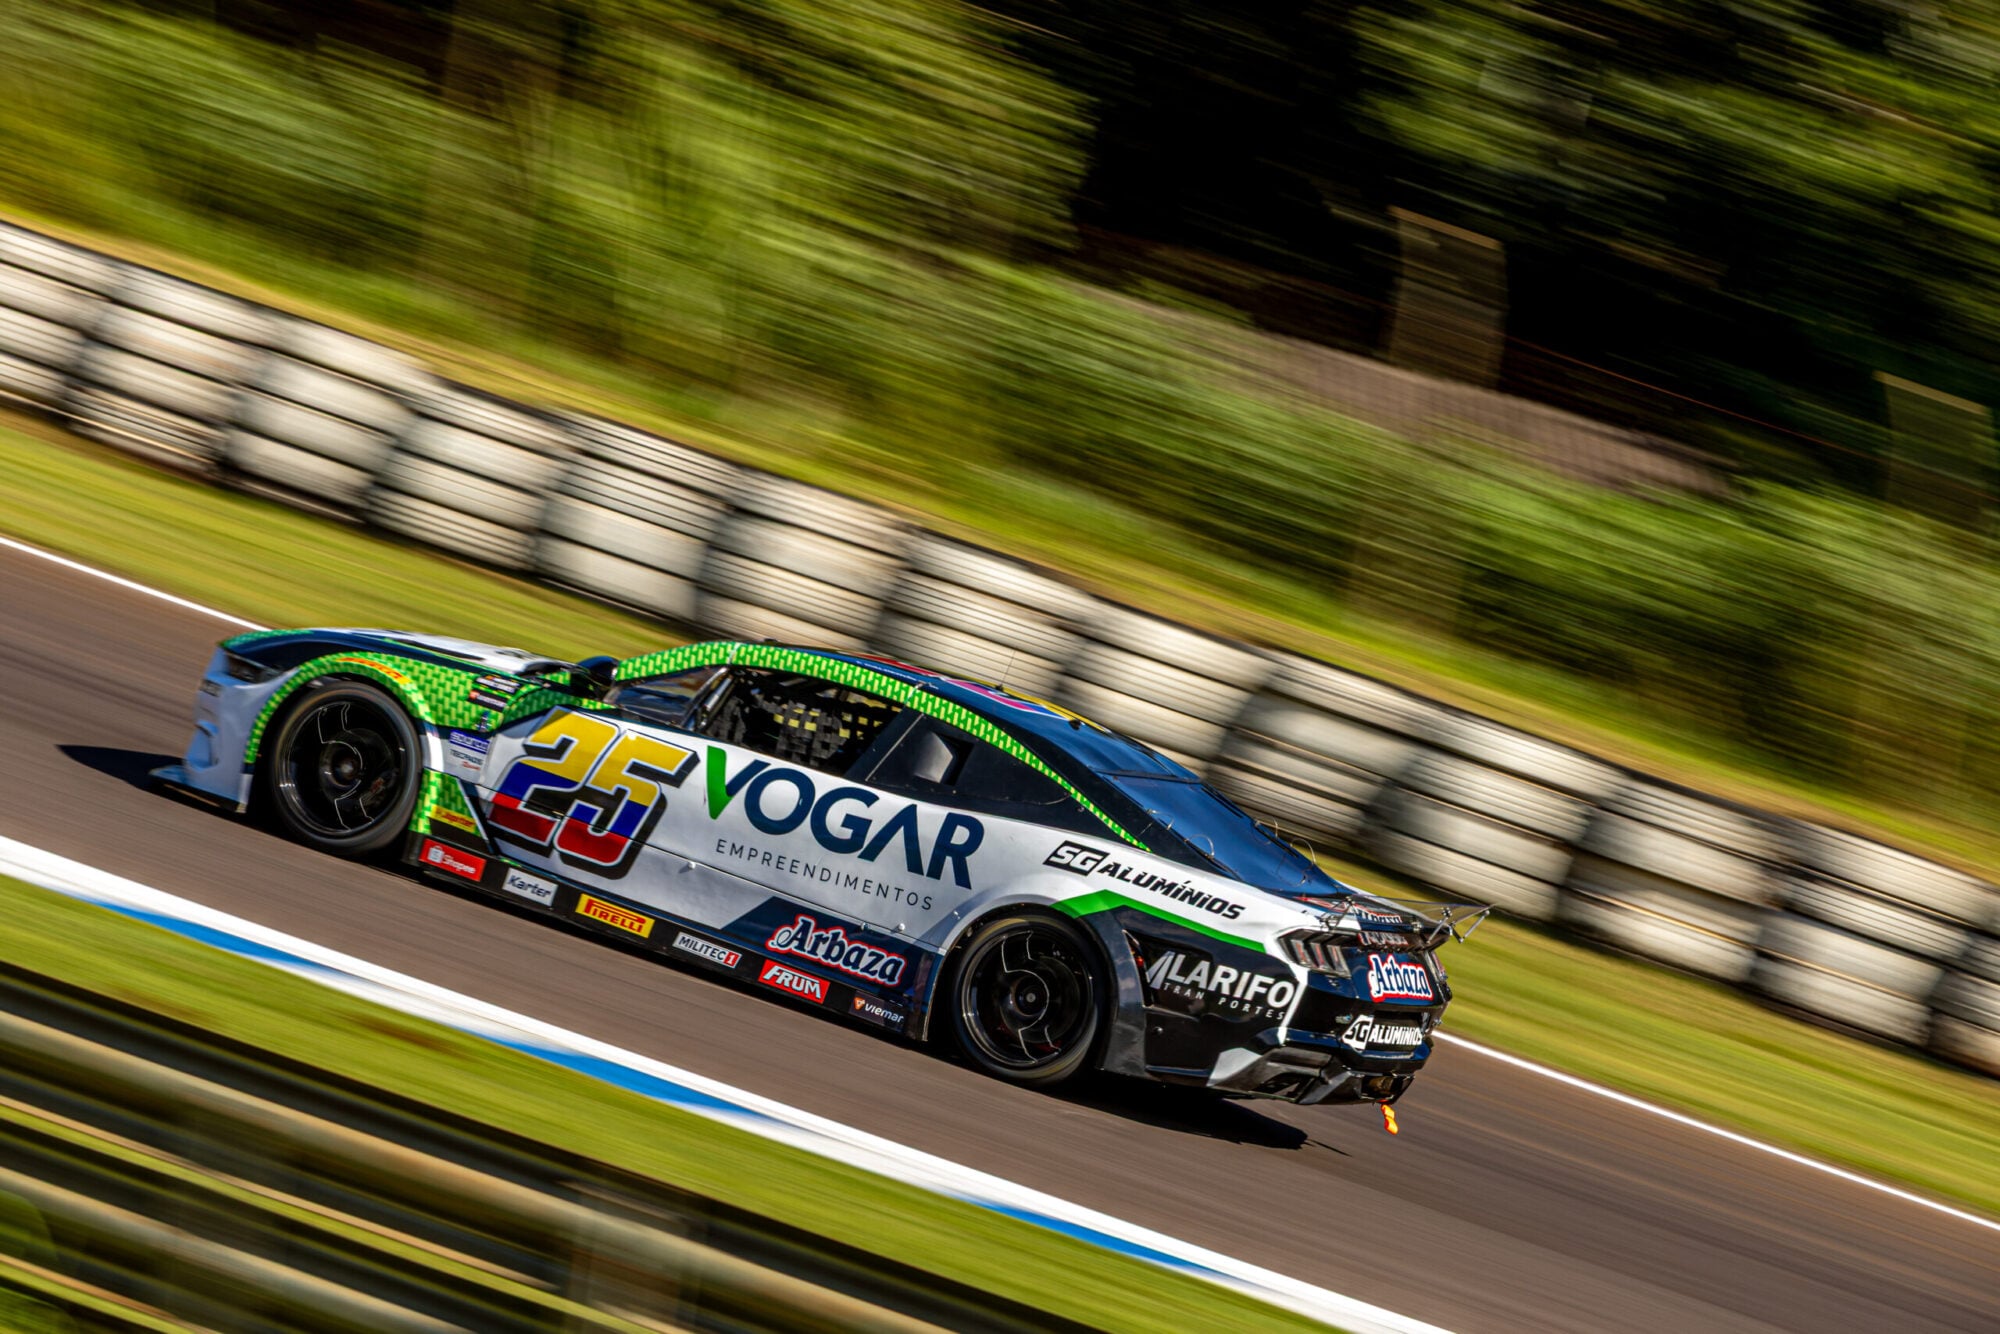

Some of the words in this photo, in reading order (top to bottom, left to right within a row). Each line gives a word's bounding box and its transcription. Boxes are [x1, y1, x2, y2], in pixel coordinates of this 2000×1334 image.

[487, 706, 697, 877] 25
[707, 745, 985, 890] VOGAR
[507, 875, 552, 898] Karter
[716, 839, 933, 911] EMPREENDIMENTOS
[1046, 843, 1106, 874] SG
[1097, 861, 1246, 920] ALUMÍNIOS
[584, 898, 647, 934] PIRELLI
[768, 915, 905, 985] Arbaza
[1370, 955, 1433, 1000] Arbaza
[763, 965, 822, 999] FRUM
[864, 1003, 904, 1023] viemar
